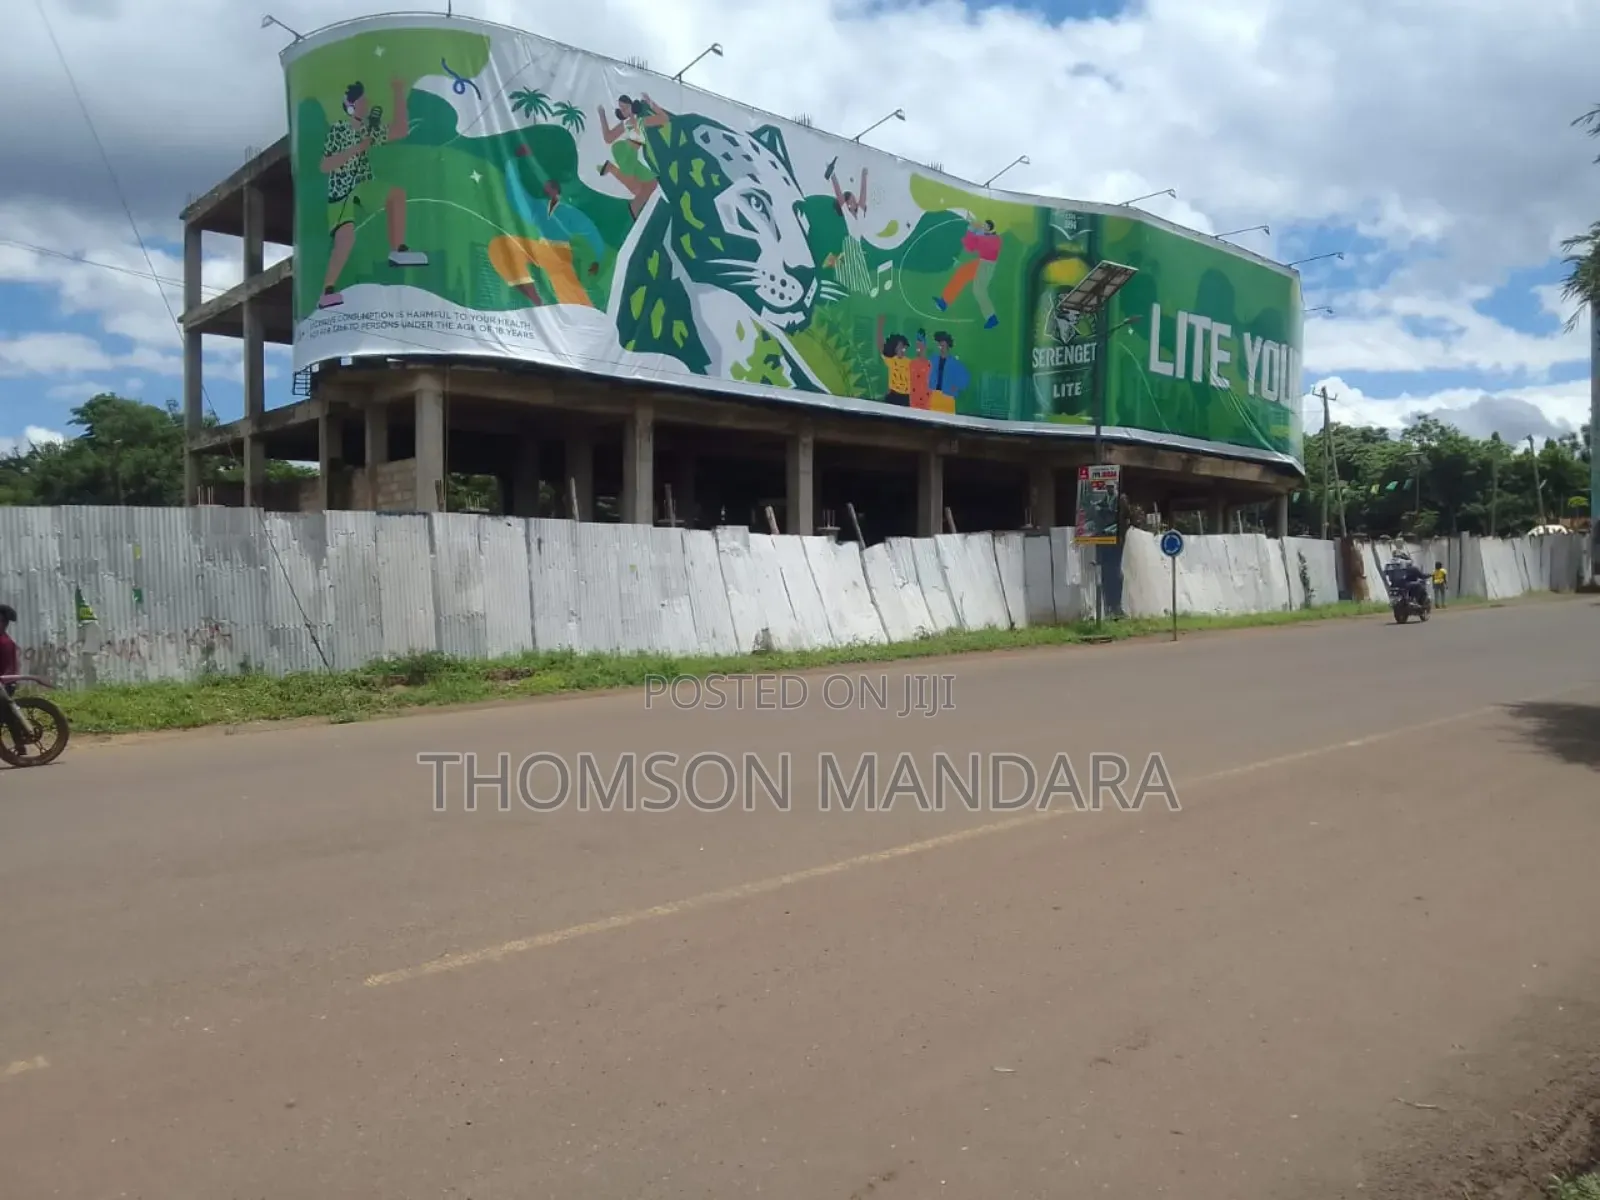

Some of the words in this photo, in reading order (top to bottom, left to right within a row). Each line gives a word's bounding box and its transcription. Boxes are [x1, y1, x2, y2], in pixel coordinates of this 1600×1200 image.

[407, 310, 451, 320] HARMFUL
[454, 312, 466, 321] TO
[470, 313, 496, 324] YOUR
[360, 320, 399, 330] PERSONS
[402, 320, 434, 330] UNDER
[436, 320, 455, 330] THE
[456, 323, 477, 333] AGE
[506, 327, 535, 339] YEARS
[1150, 303, 1231, 388] LITE
[1032, 342, 1097, 369] SERENGET
[1053, 381, 1082, 398] LITE
